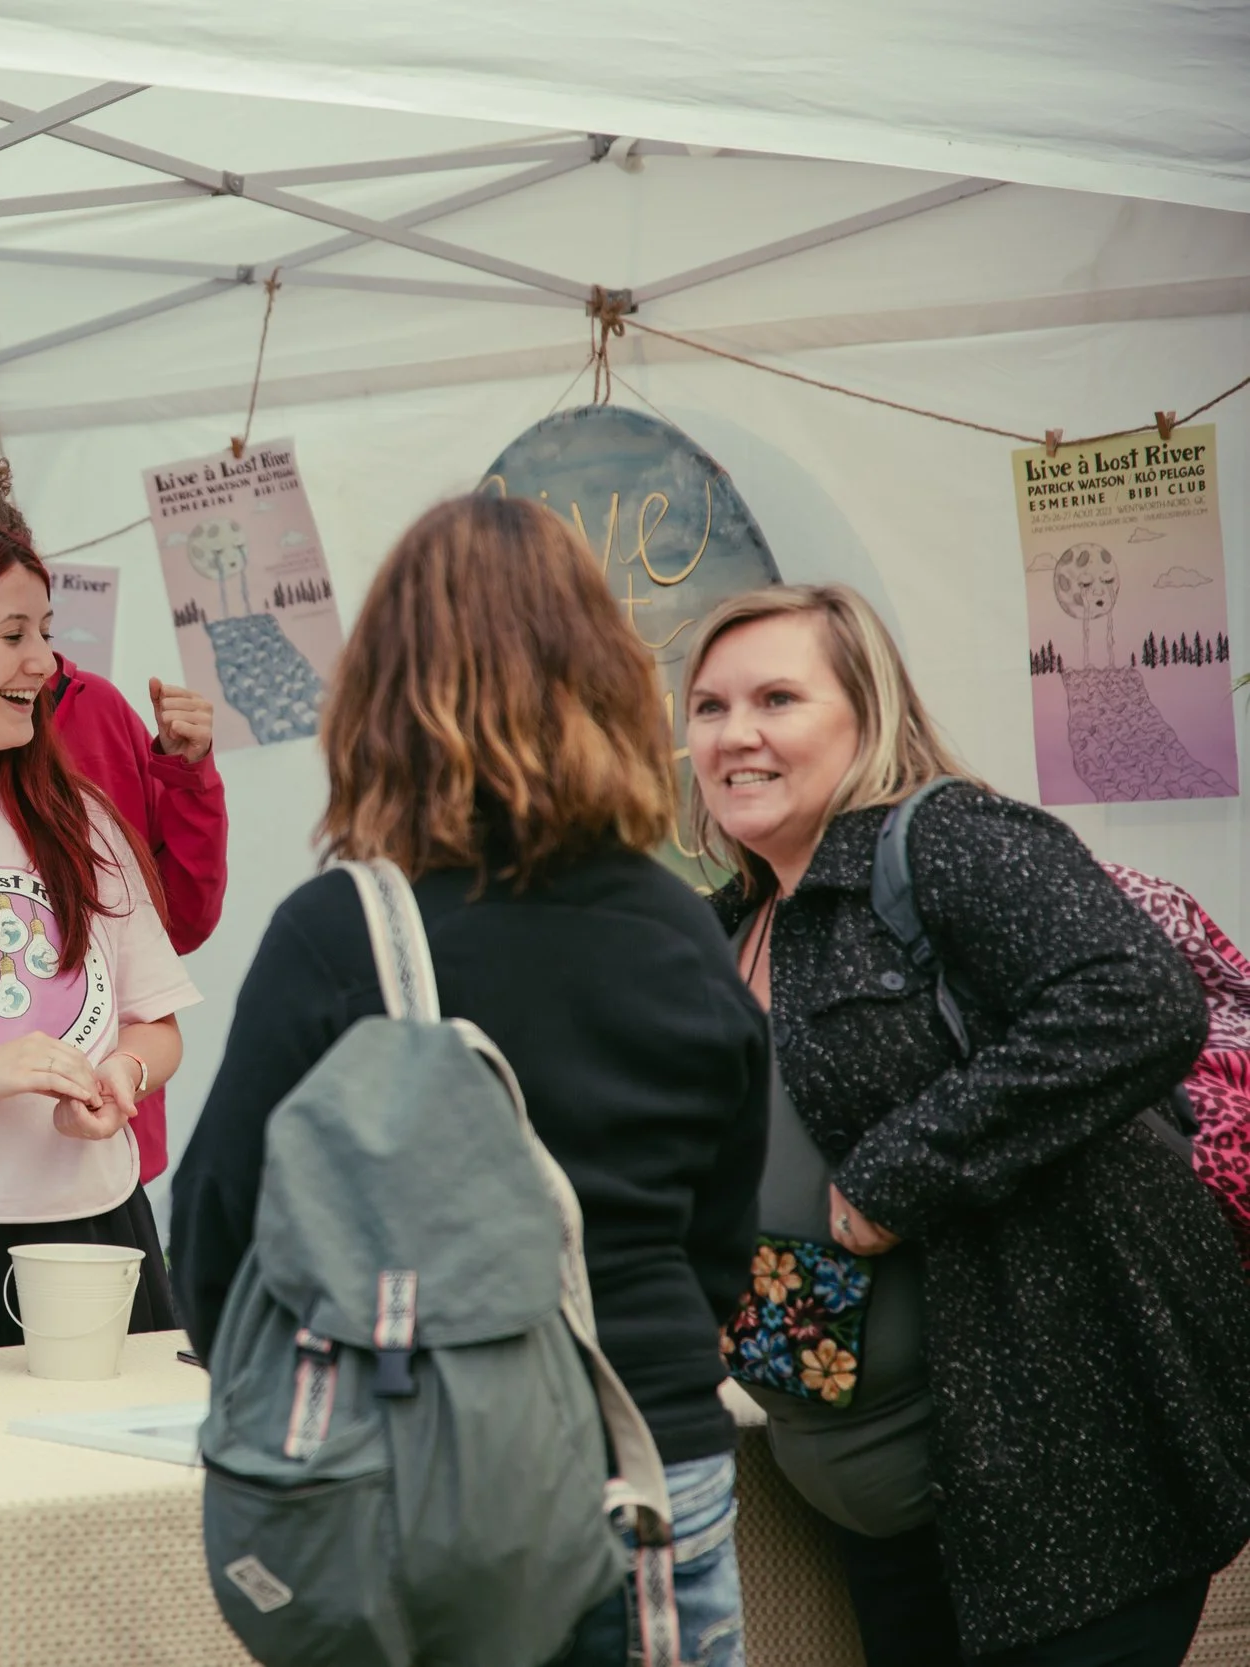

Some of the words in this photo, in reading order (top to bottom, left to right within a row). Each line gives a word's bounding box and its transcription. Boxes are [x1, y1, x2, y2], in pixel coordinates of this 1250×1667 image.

[154, 472, 198, 492] Live
[220, 455, 257, 478] Lost
[1026, 459, 1071, 481] Live
[1078, 454, 1090, 475] à
[1095, 448, 1139, 473] Lost
[1144, 443, 1206, 467] River
[1027, 481, 1075, 497] PATRICK
[1078, 474, 1125, 490] WATSON
[1160, 464, 1206, 481] PELGAG
[1029, 492, 1106, 512] ESMERINE
[1129, 485, 1158, 500] BIBI
[1168, 480, 1206, 496] CLUB
[62, 573, 111, 593] River
